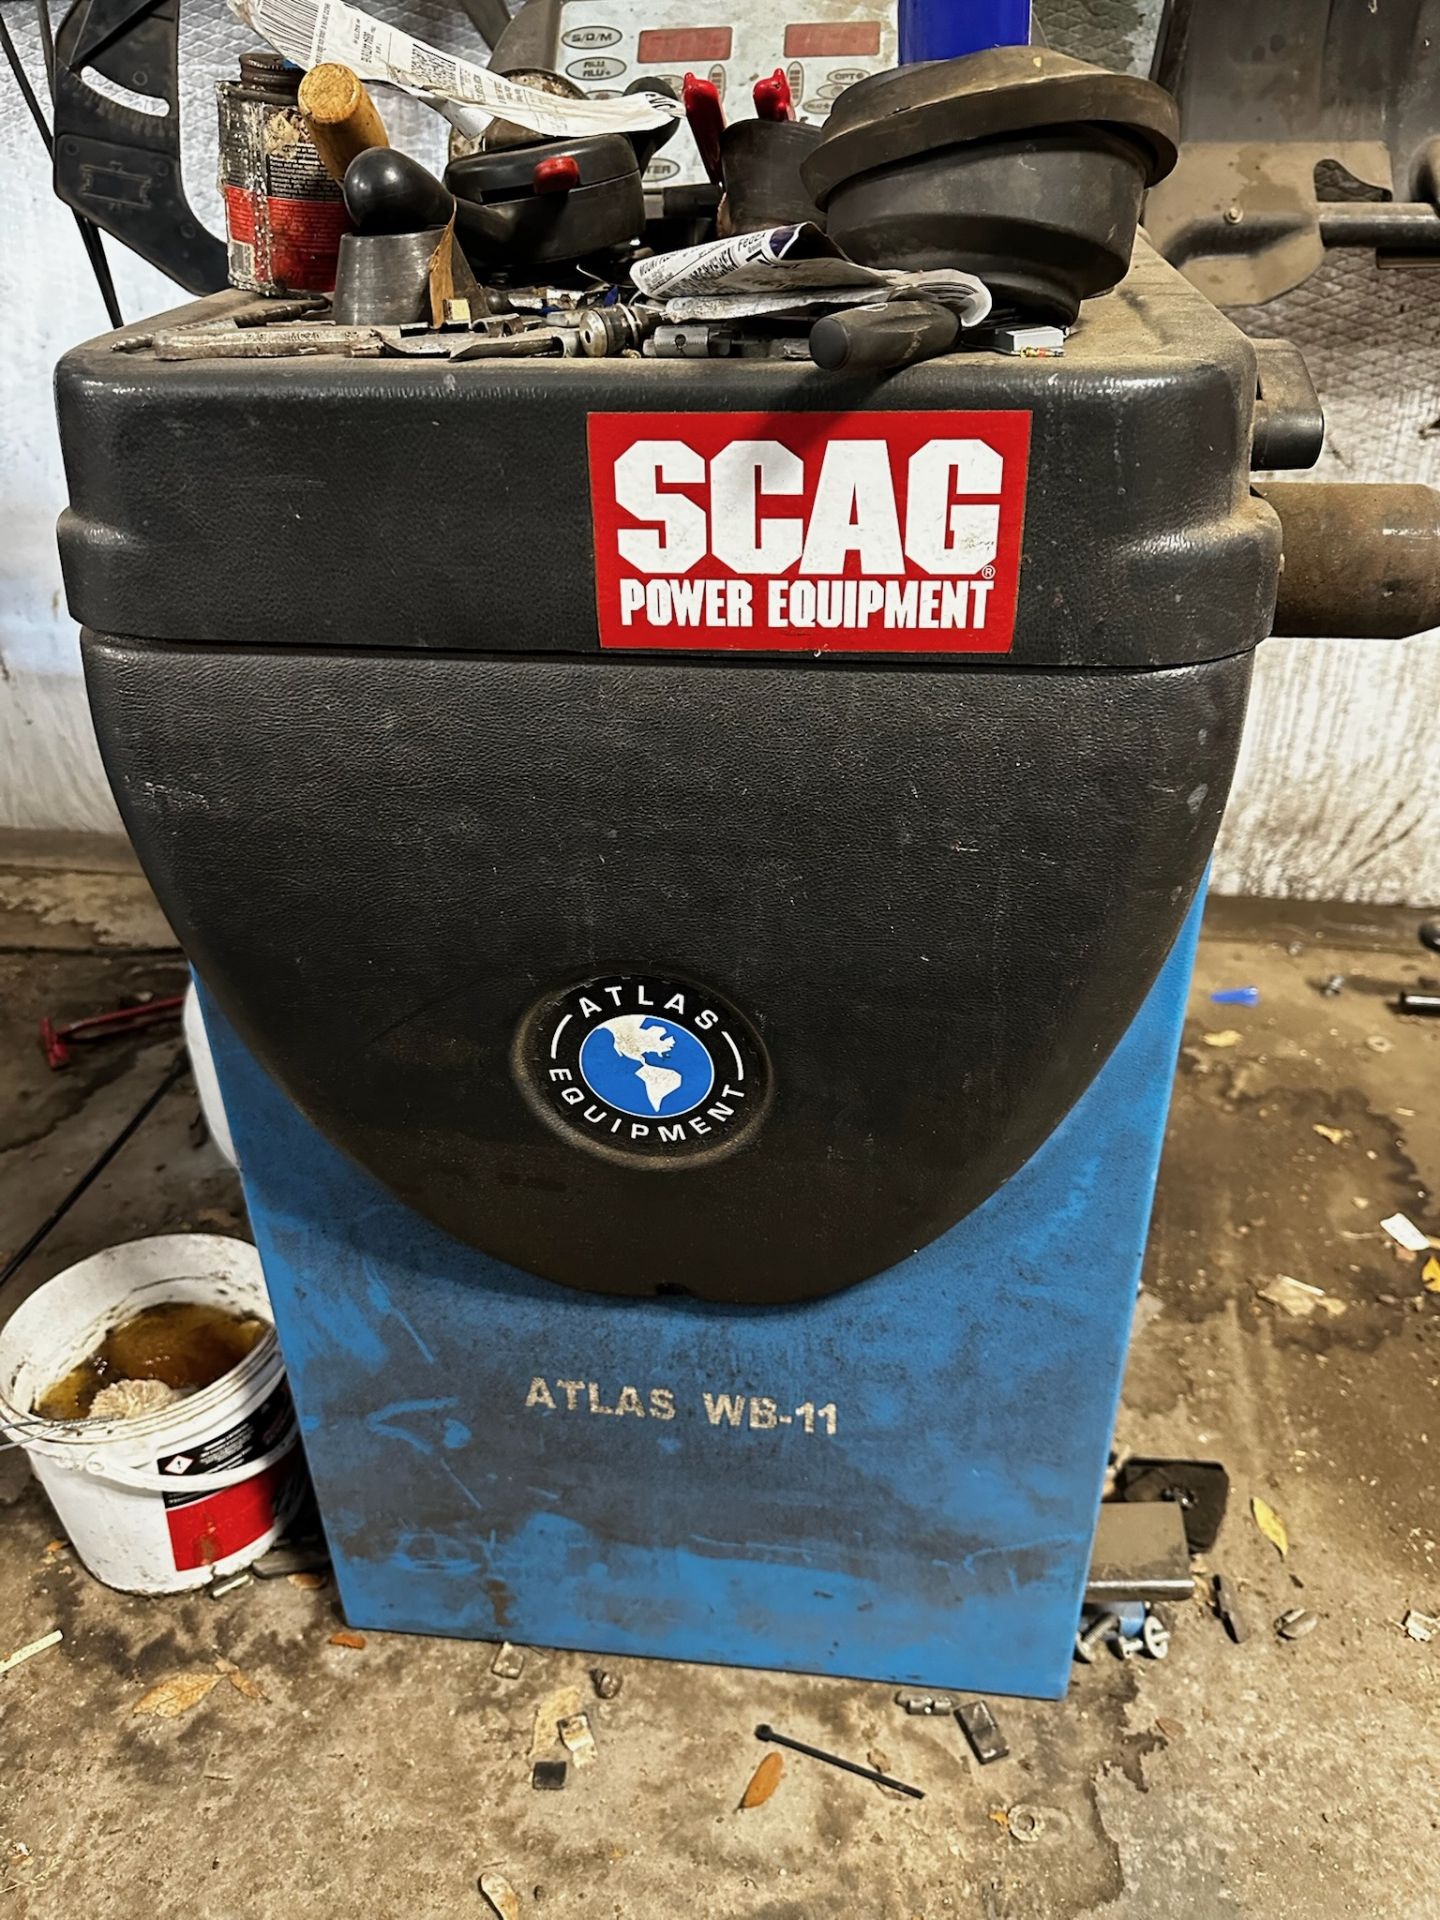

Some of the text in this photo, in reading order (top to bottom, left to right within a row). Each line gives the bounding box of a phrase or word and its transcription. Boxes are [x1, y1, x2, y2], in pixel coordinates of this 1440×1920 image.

[619, 577, 996, 630] POWER EQUIPMENT
[578, 984, 719, 1032] ATLAS
[548, 1067, 745, 1143] EQUIPMENT
[524, 1376, 838, 1436] ATLAS WB-11
